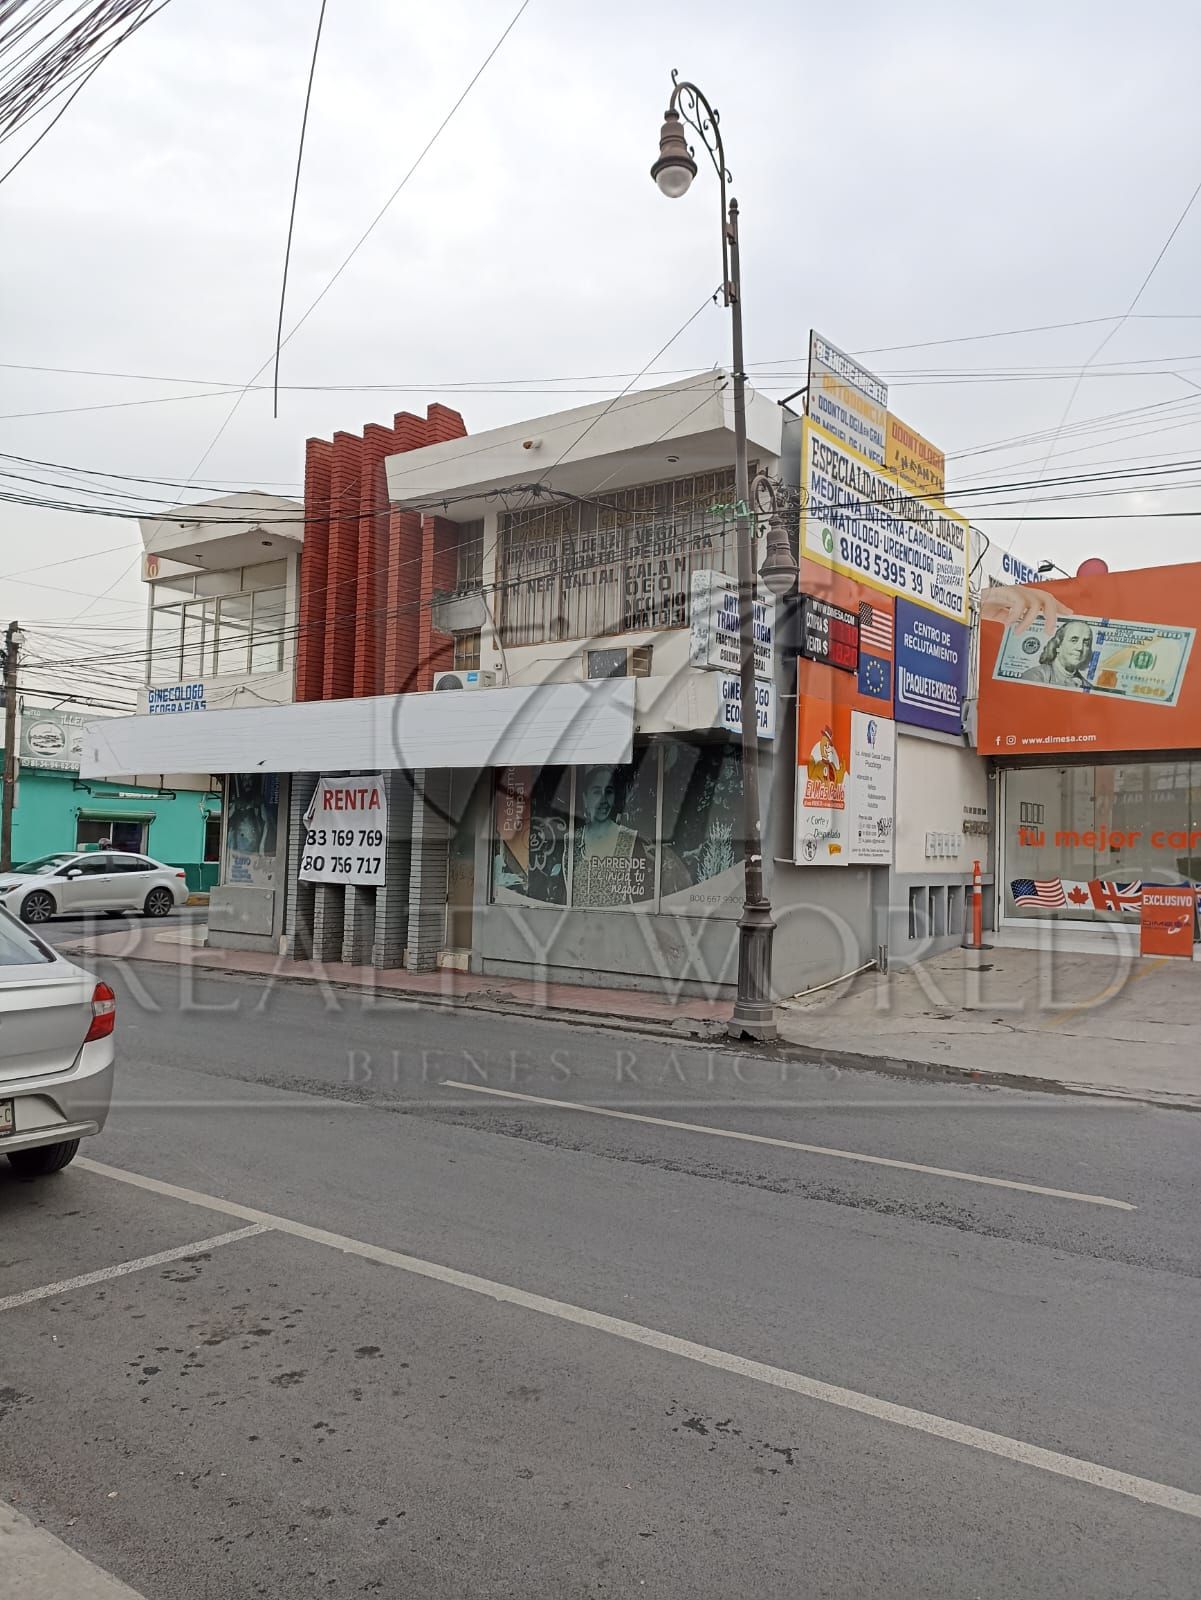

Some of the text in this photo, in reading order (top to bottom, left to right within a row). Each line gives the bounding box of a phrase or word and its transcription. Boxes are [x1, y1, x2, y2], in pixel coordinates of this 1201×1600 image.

[812, 437, 894, 511] ESPECIALIDADES
[812, 471, 861, 514] MEDICINA
[840, 537, 923, 594] 8183 5395 39
[930, 583, 962, 612] UROLOGO
[806, 612, 822, 632] COMPRA
[806, 634, 822, 653] VENTA
[914, 621, 951, 646] CENTRO DE
[904, 633, 958, 664] RECLUTAMIENTO
[148, 684, 204, 703] GINECOLOGO
[906, 672, 957, 703] PAQUETEXPRESS
[1022, 734, 1097, 745] www.dimesa.com
[323, 789, 381, 810] RENTA
[513, 782, 525, 831] Grupal
[811, 816, 825, 825] Corte
[358, 830, 383, 846] 769
[1018, 827, 1045, 848] tu
[1055, 825, 1142, 853] mejor
[331, 857, 352, 873] 756
[357, 858, 381, 874] 717
[592, 857, 646, 869] EMPRENDE
[634, 870, 645, 882] tu
[611, 883, 645, 900] negocio
[1143, 895, 1192, 907] EXCLUSIVO
